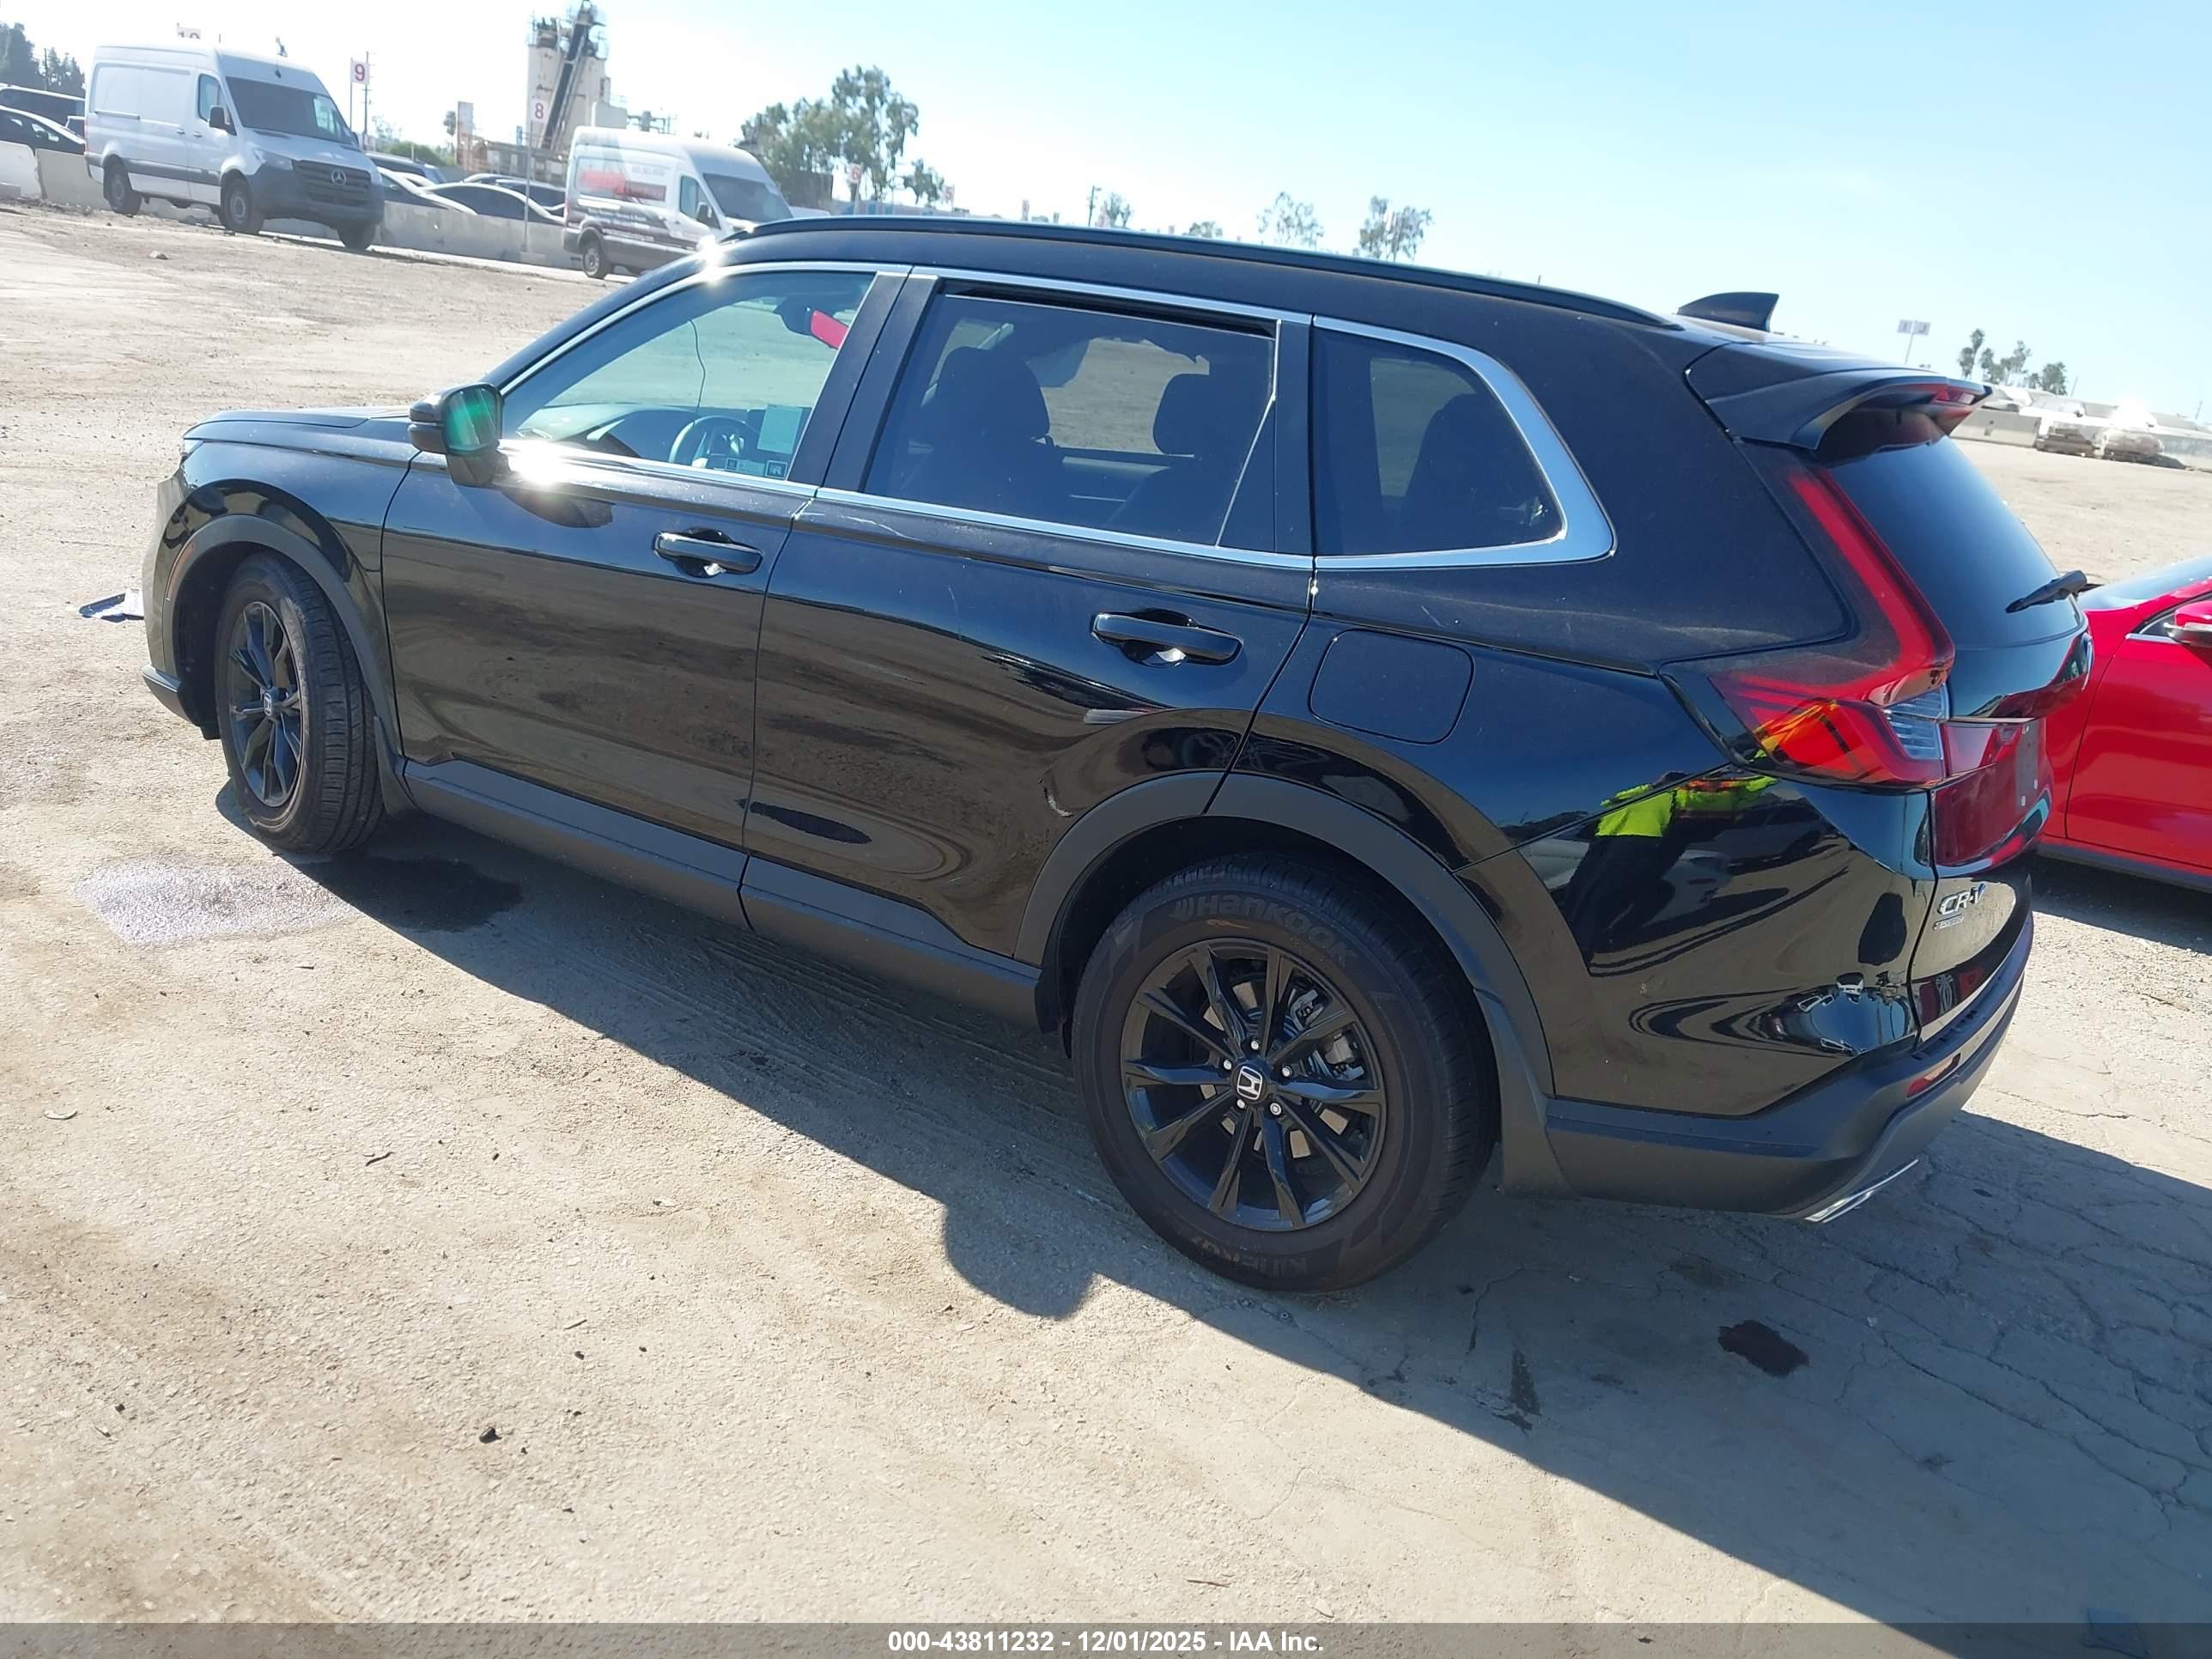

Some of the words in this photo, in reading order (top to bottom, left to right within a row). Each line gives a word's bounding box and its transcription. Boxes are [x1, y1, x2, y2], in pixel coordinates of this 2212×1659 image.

[354, 64, 365, 82] 9
[535, 102, 544, 118] 8
[1938, 884, 1986, 915] CR-V
